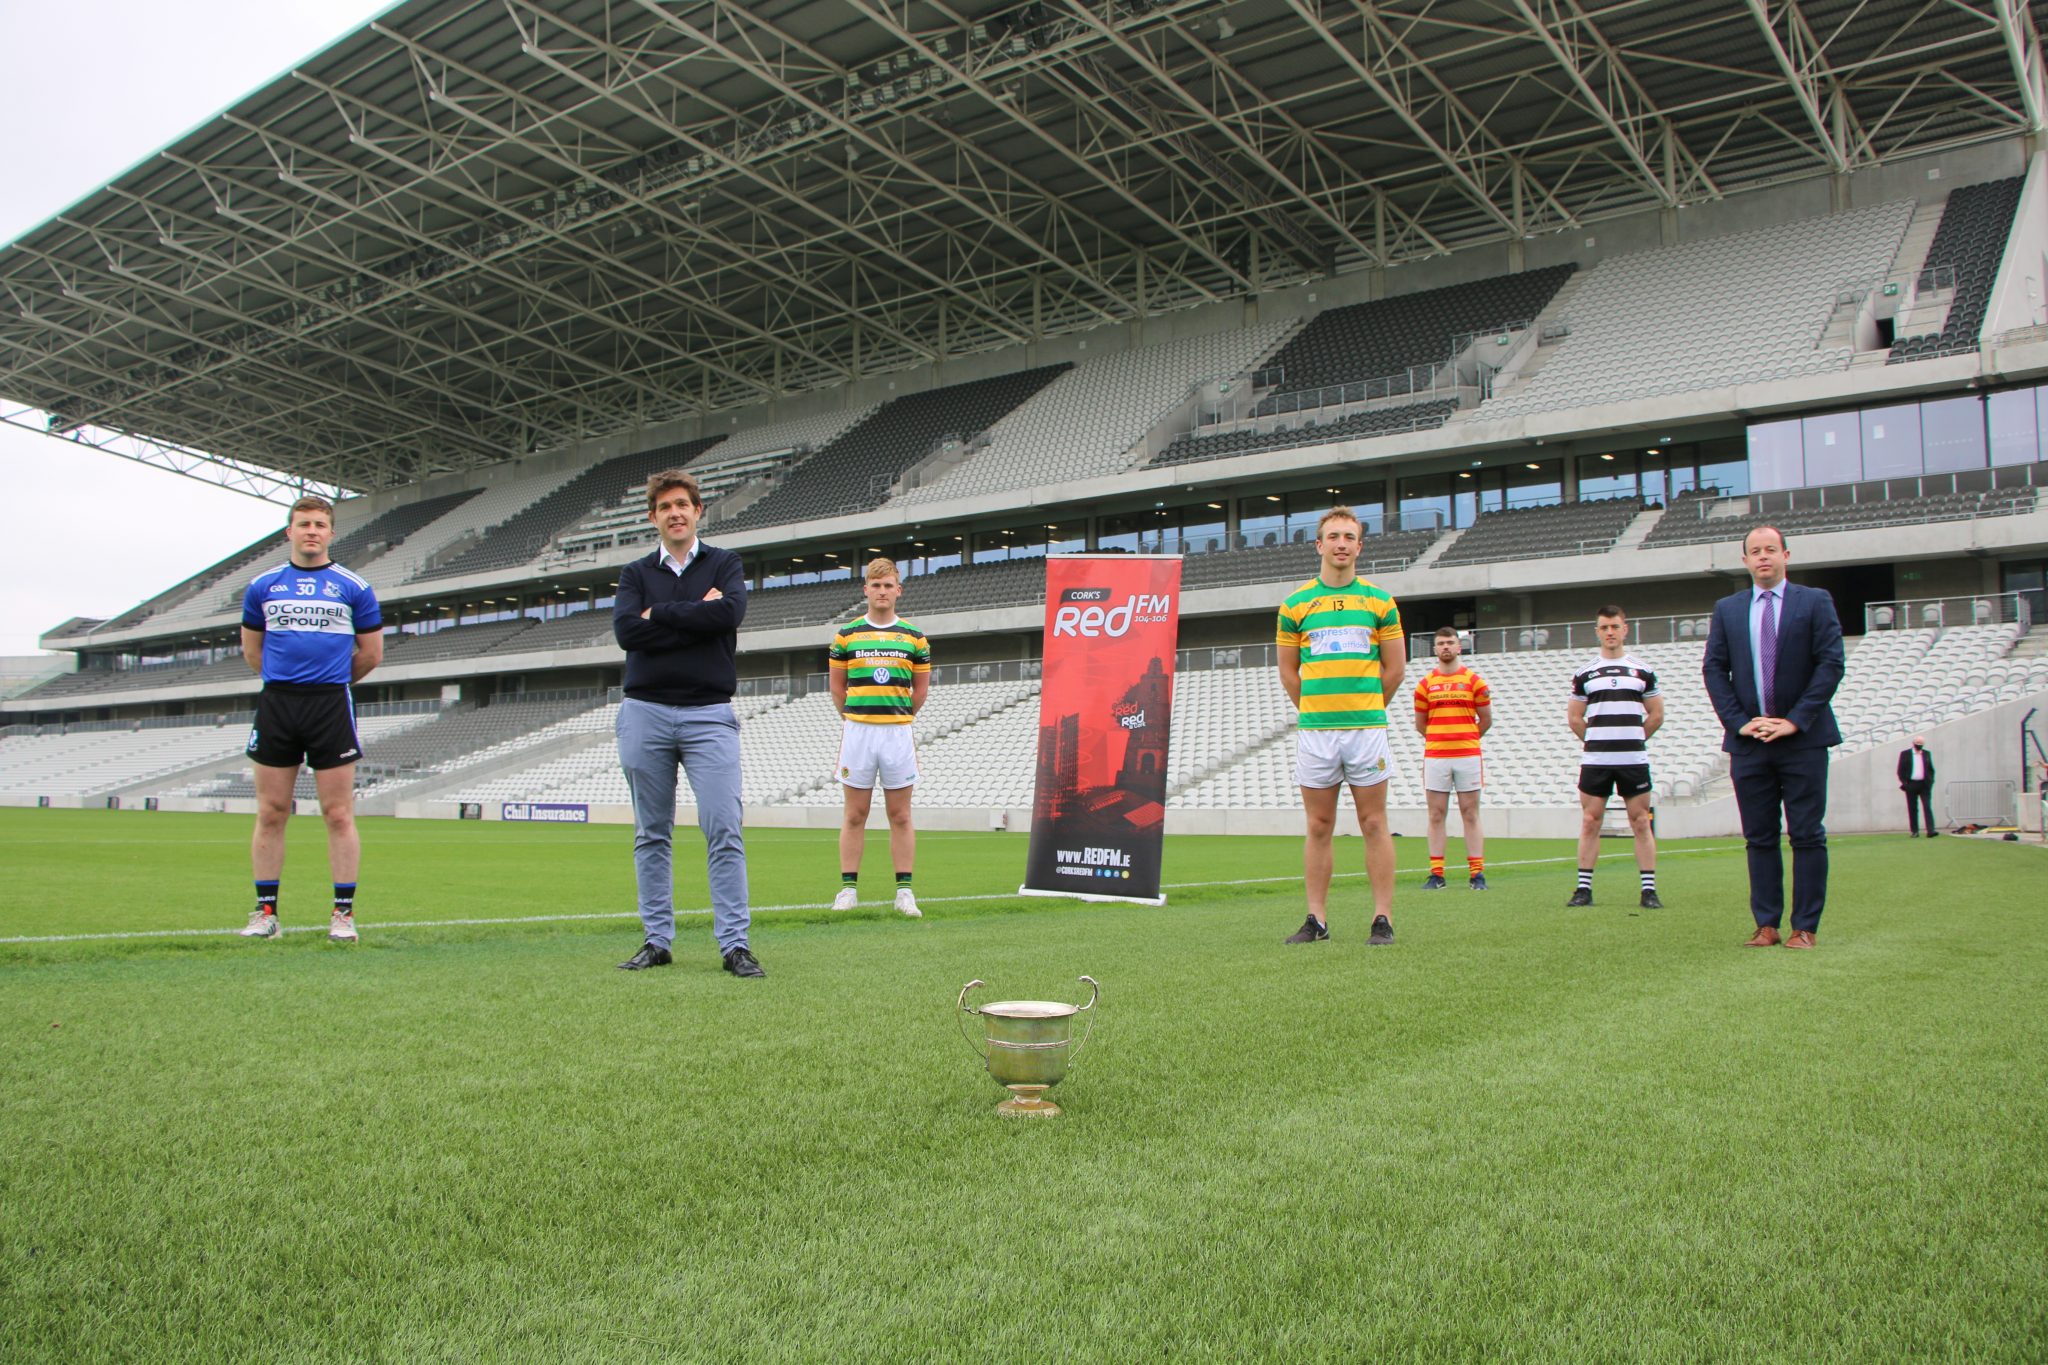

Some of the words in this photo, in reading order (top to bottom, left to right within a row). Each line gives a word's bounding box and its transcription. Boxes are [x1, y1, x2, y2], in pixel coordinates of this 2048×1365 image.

[296, 583, 315, 595] 30
[1071, 591, 1101, 600] CORK'S
[267, 603, 343, 617] O'Connell
[1333, 600, 1345, 612] 13
[277, 615, 330, 628] Group
[1053, 595, 1136, 637] Red
[1136, 594, 1170, 614] FM
[1134, 614, 1168, 623] 104-106
[855, 649, 908, 659] Blackwater
[865, 658, 898, 666] Motors
[1611, 679, 1617, 687] 9
[504, 804, 530, 820] Chill
[531, 805, 586, 820] Insurance
